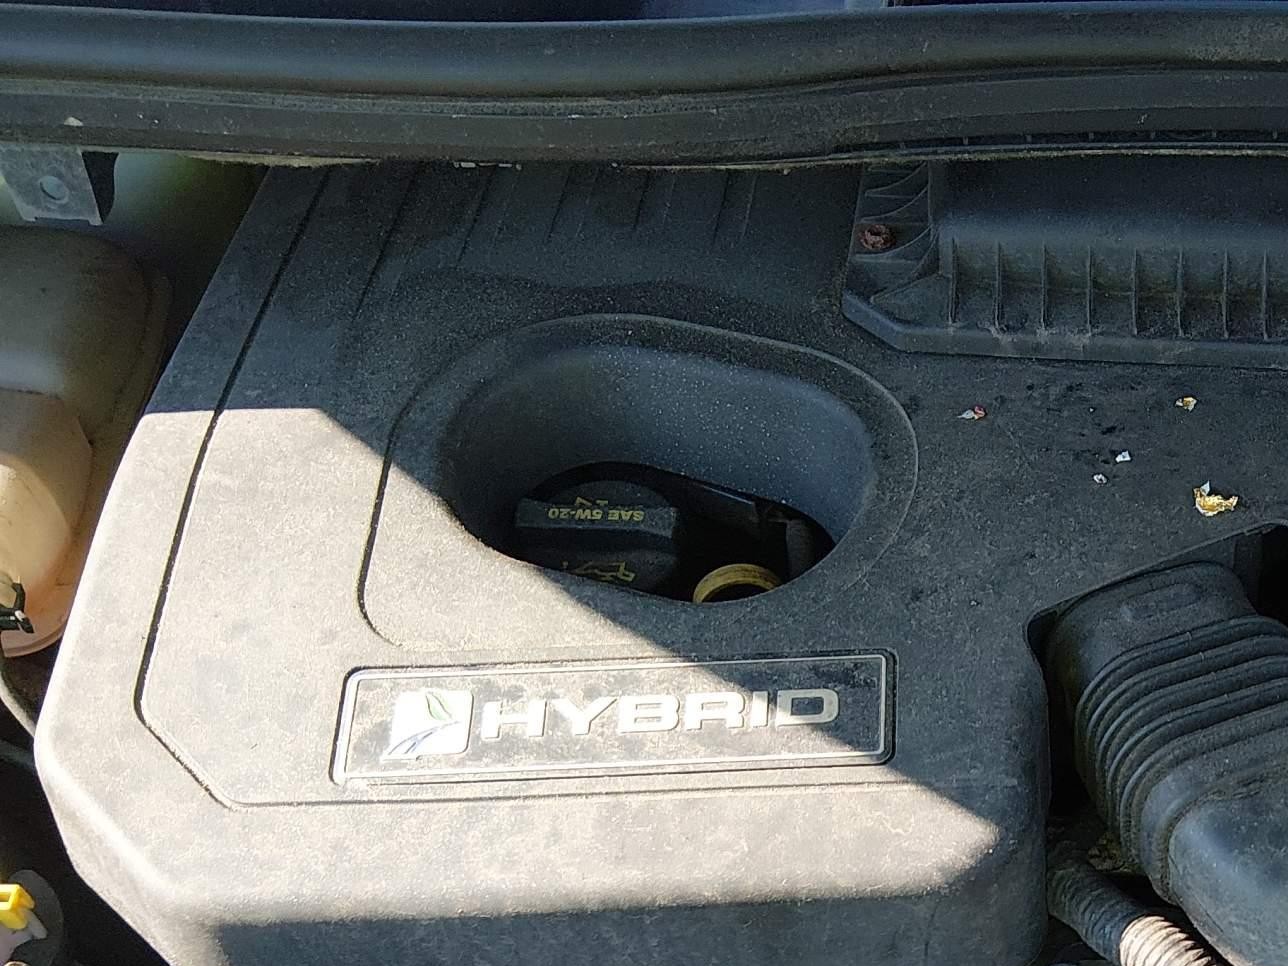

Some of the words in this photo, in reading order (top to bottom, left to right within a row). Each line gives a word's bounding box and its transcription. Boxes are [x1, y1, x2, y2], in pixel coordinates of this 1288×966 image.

[548, 508, 603, 521] 5W-20
[608, 510, 645, 522] SAE
[482, 688, 840, 740] HYBRID
